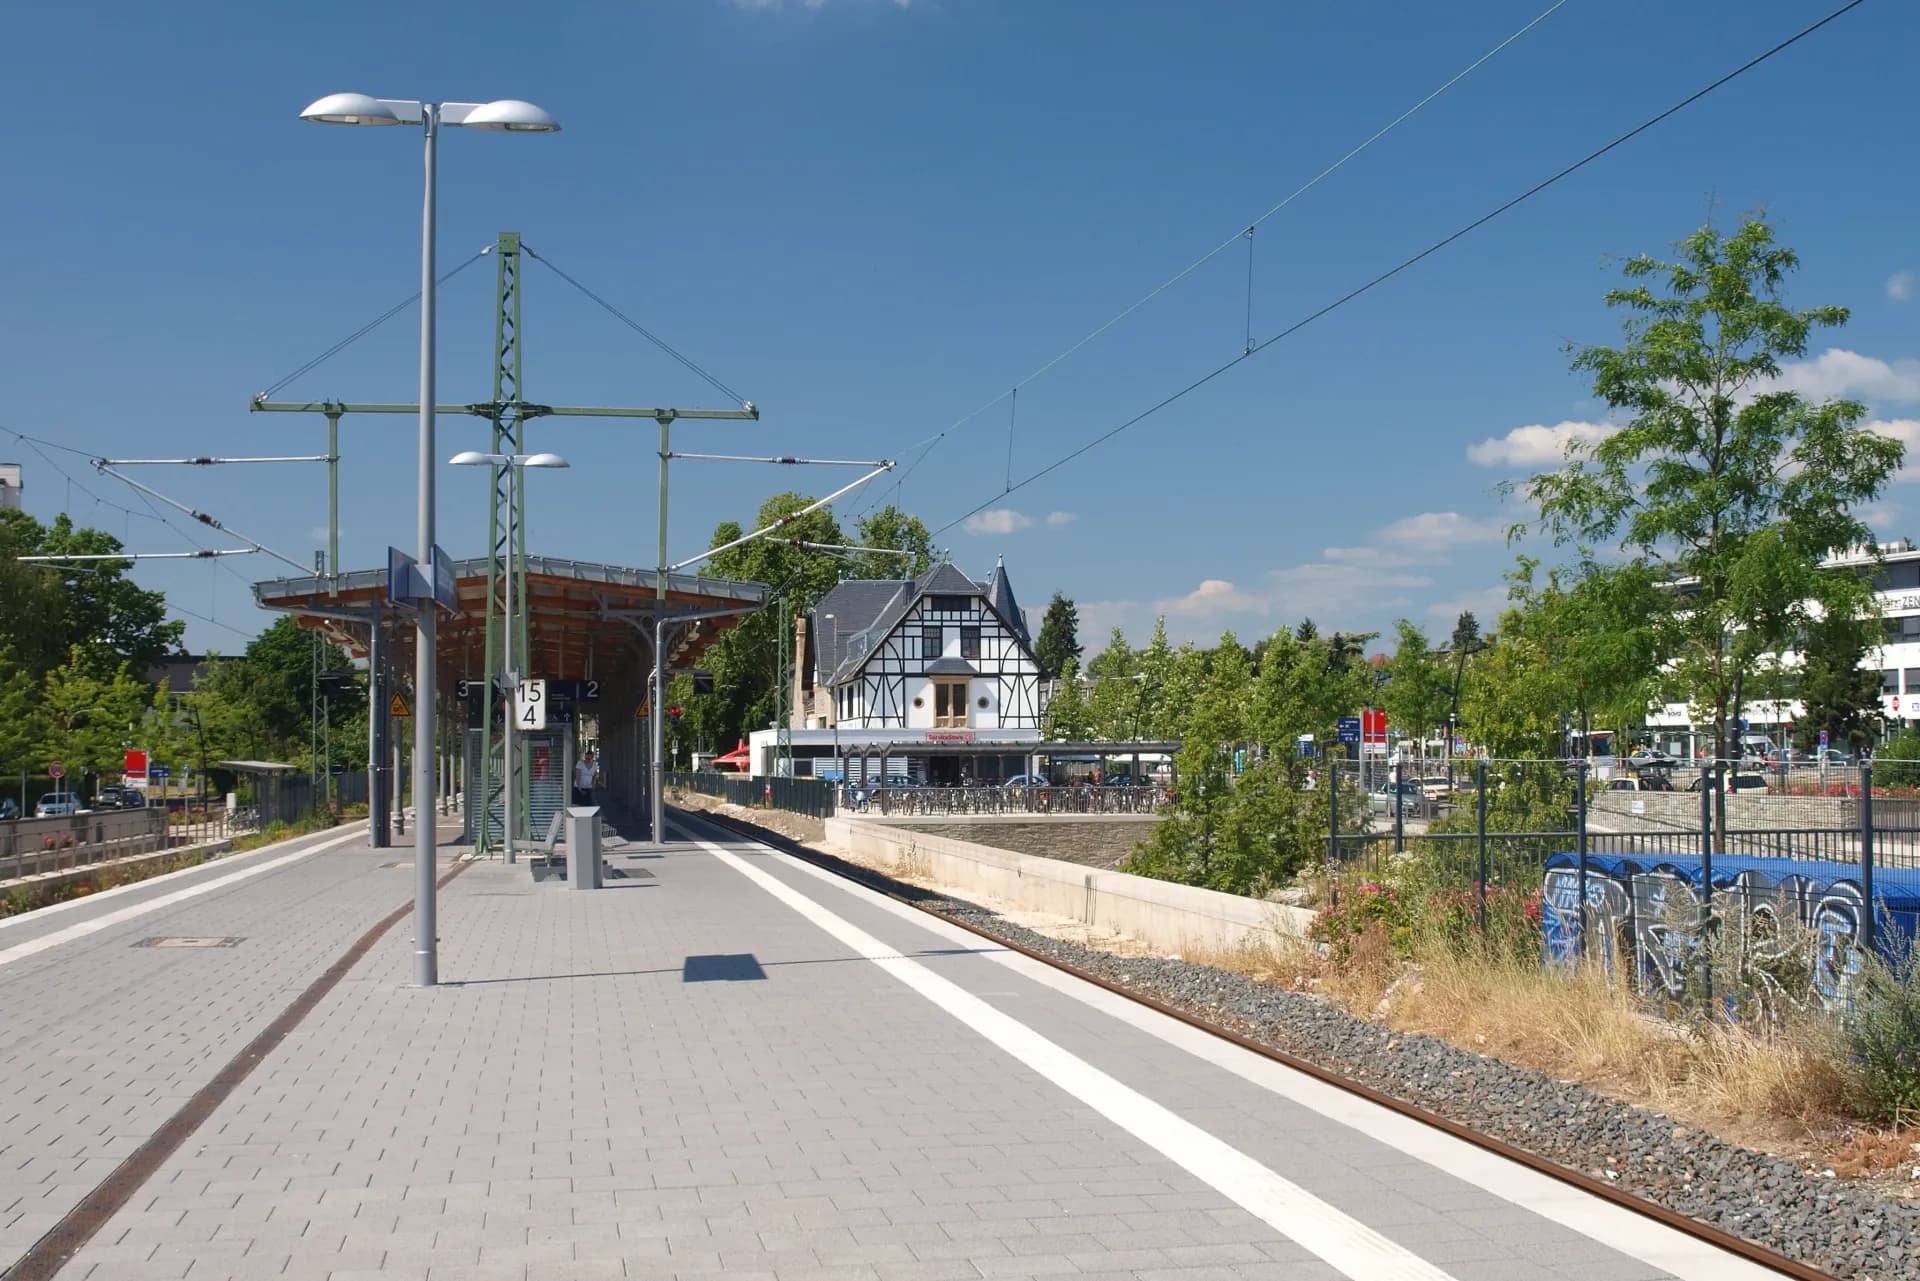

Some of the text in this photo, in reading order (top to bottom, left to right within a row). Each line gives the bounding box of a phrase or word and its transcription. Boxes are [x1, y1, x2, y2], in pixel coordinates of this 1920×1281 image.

[457, 680, 469, 697] 3
[519, 682, 541, 703] 15
[586, 681, 599, 697] 2
[522, 705, 537, 725] 4
